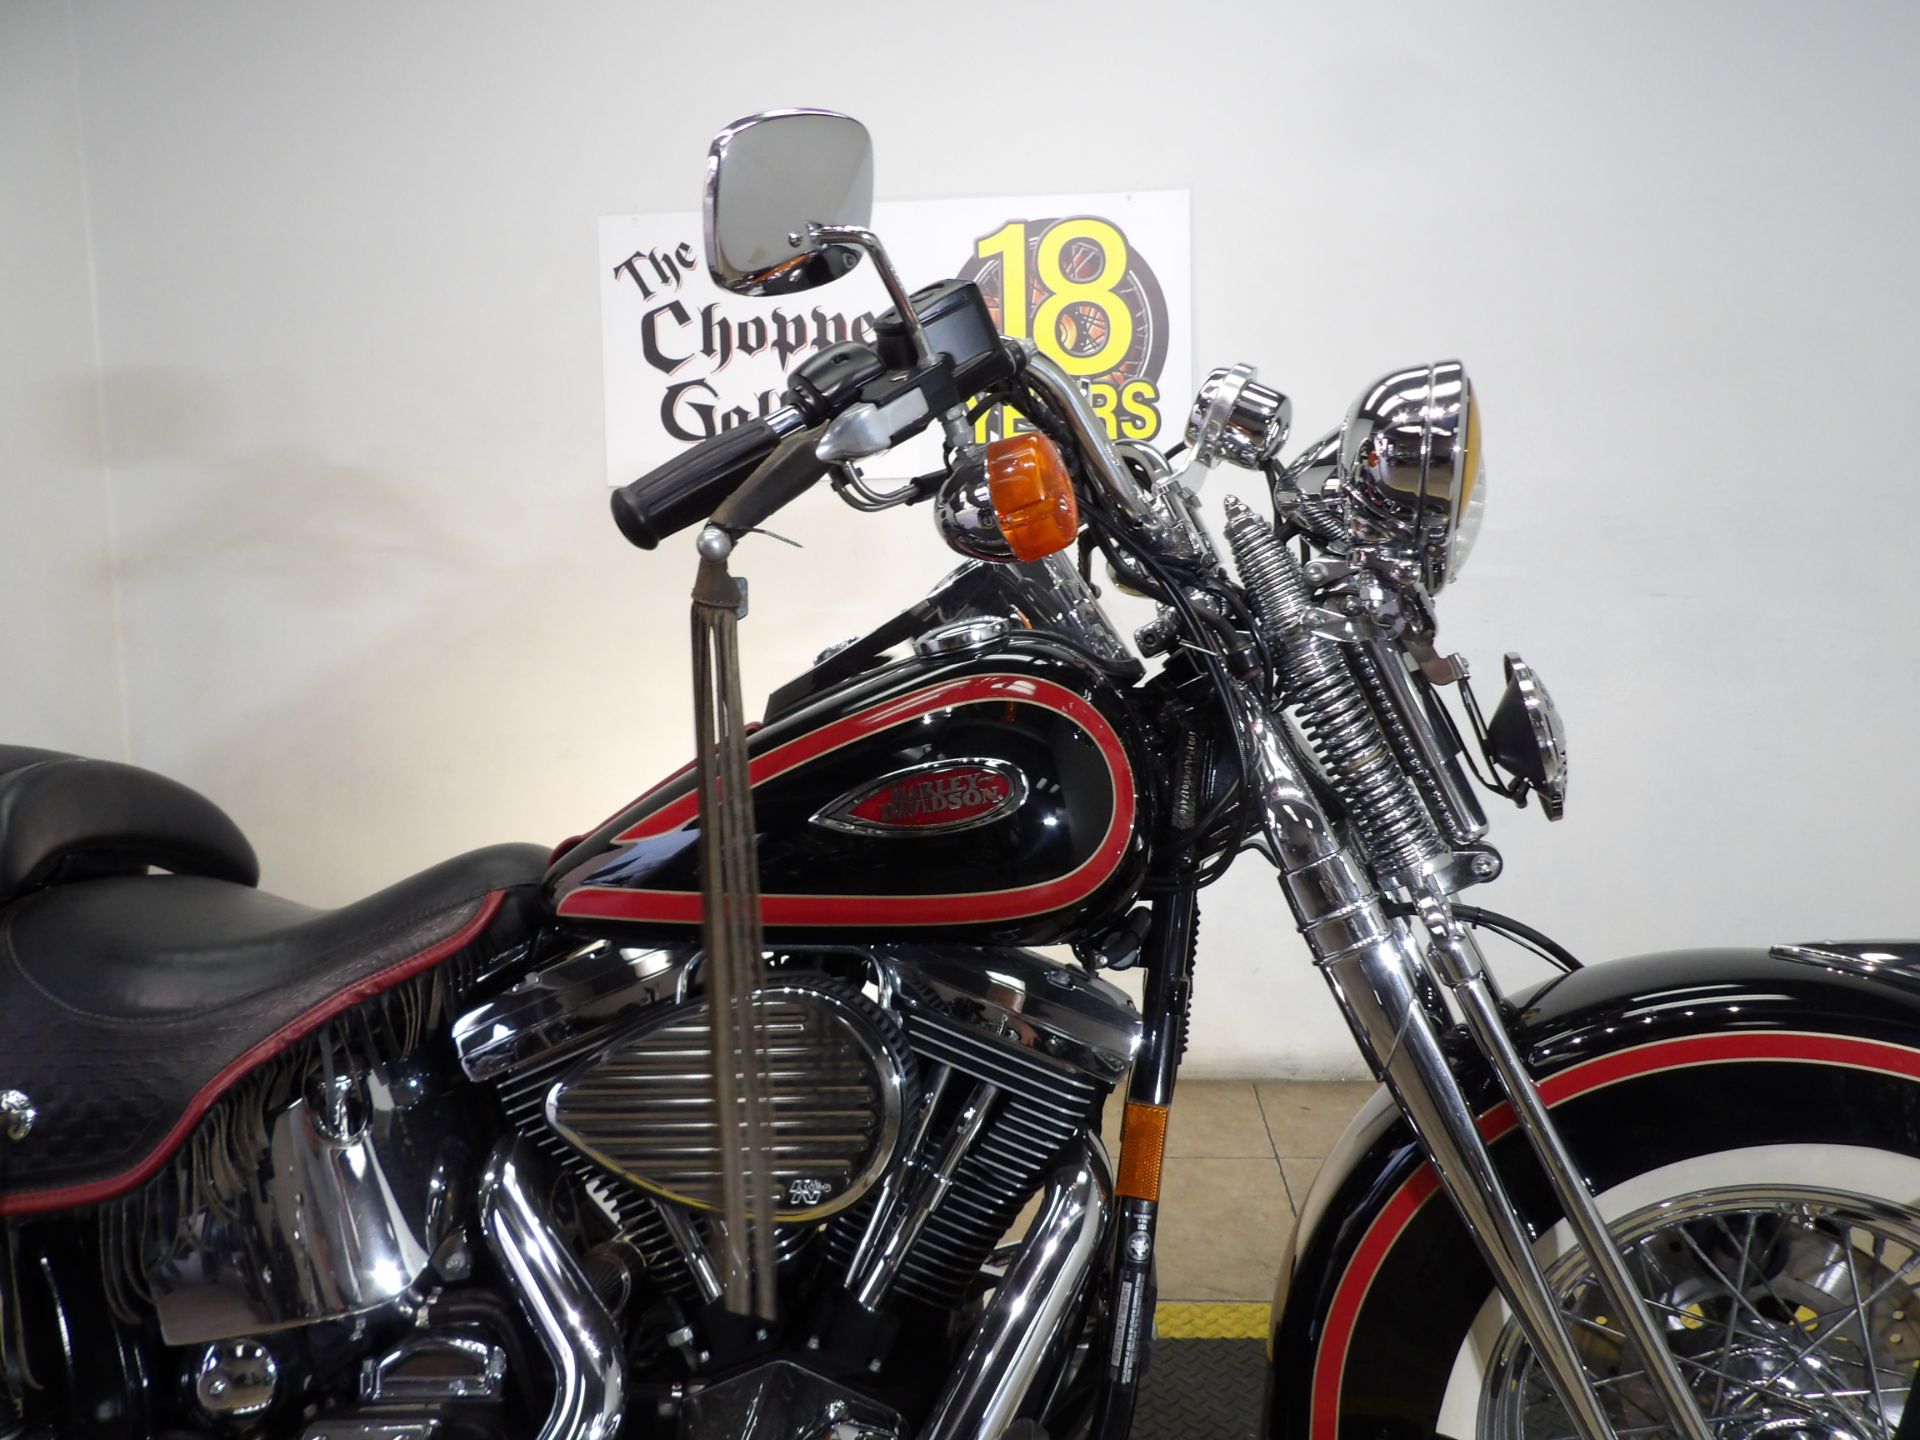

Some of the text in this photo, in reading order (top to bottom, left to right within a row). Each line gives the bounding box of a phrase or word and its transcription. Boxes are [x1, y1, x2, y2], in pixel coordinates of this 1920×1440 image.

[613, 241, 697, 303] The
[977, 219, 1133, 376] 18
[641, 300, 877, 377] Choppe
[966, 381, 1158, 444] YERS
[880, 786, 1000, 820] DAVIDSON
